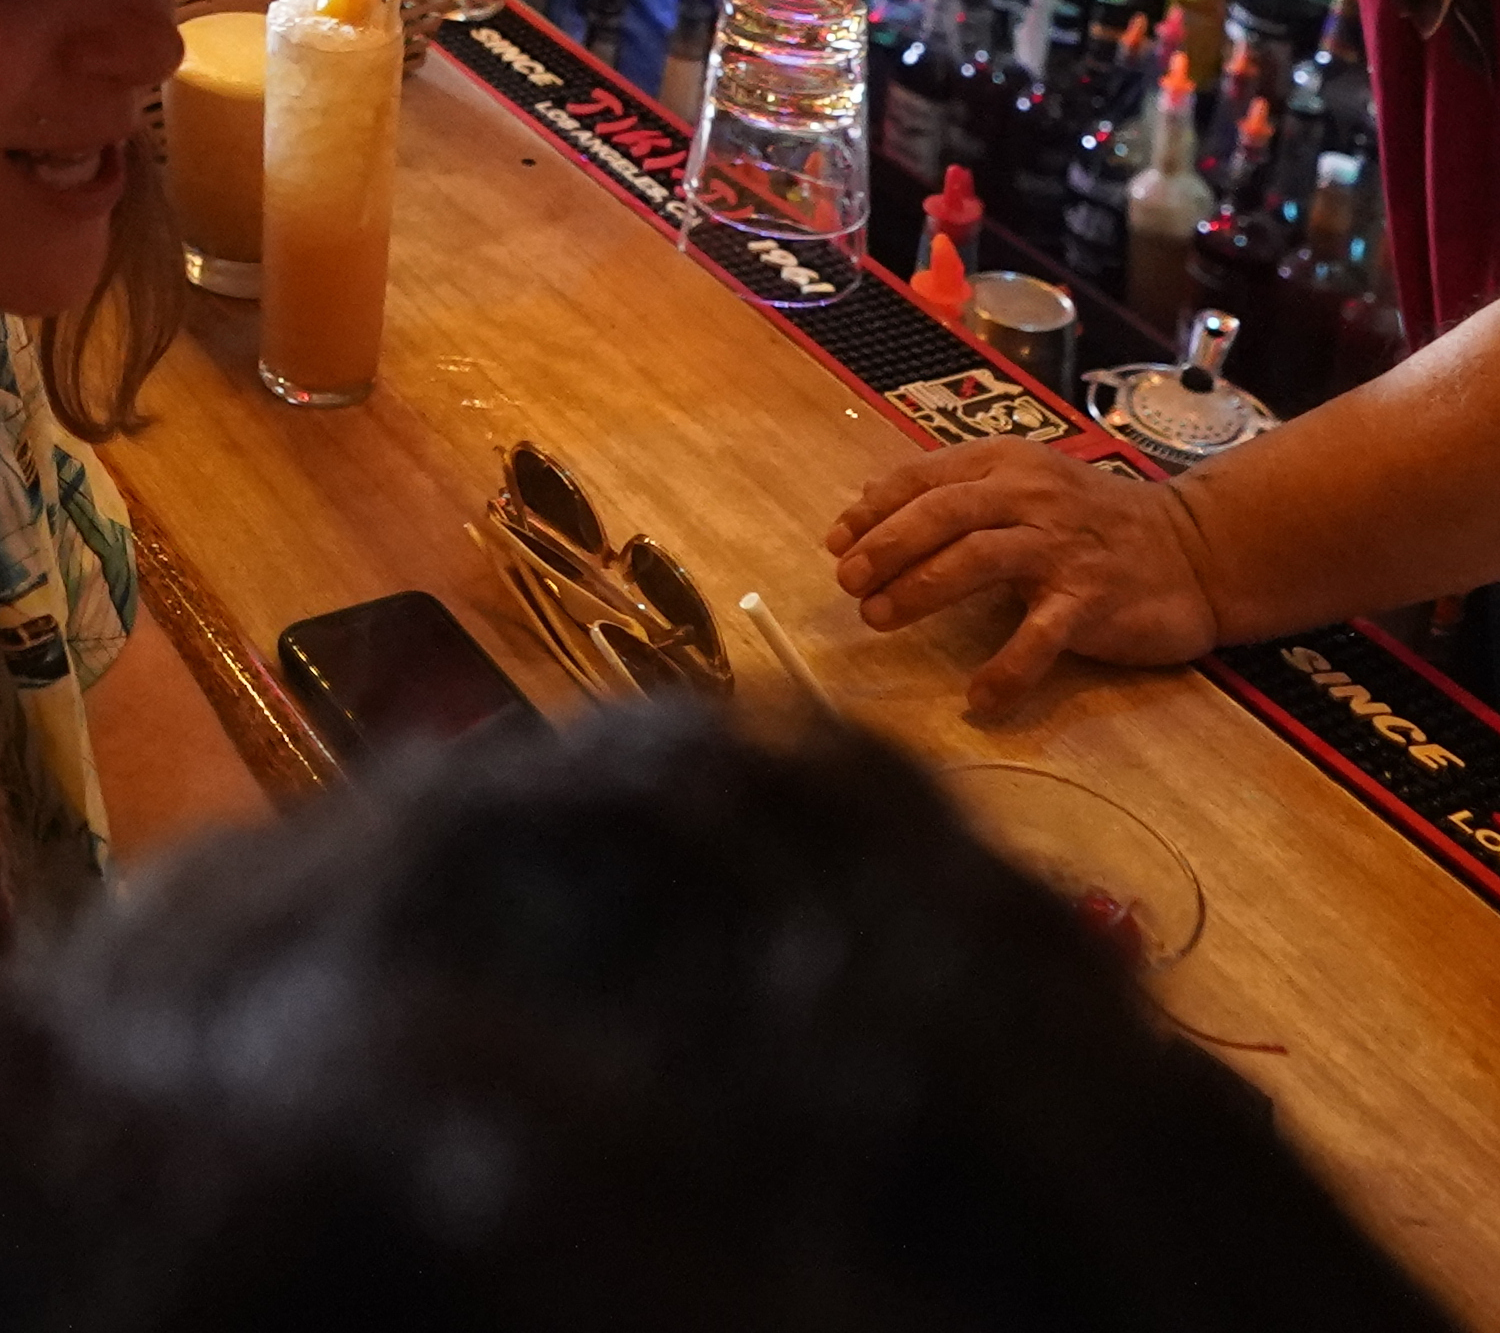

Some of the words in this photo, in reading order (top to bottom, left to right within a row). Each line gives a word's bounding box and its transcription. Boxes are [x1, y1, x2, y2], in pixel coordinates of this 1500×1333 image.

[470, 26, 564, 88] SINCE
[534, 100, 582, 132] LOS
[746, 238, 836, 294] 1961
[1280, 645, 1467, 771] SINCE
